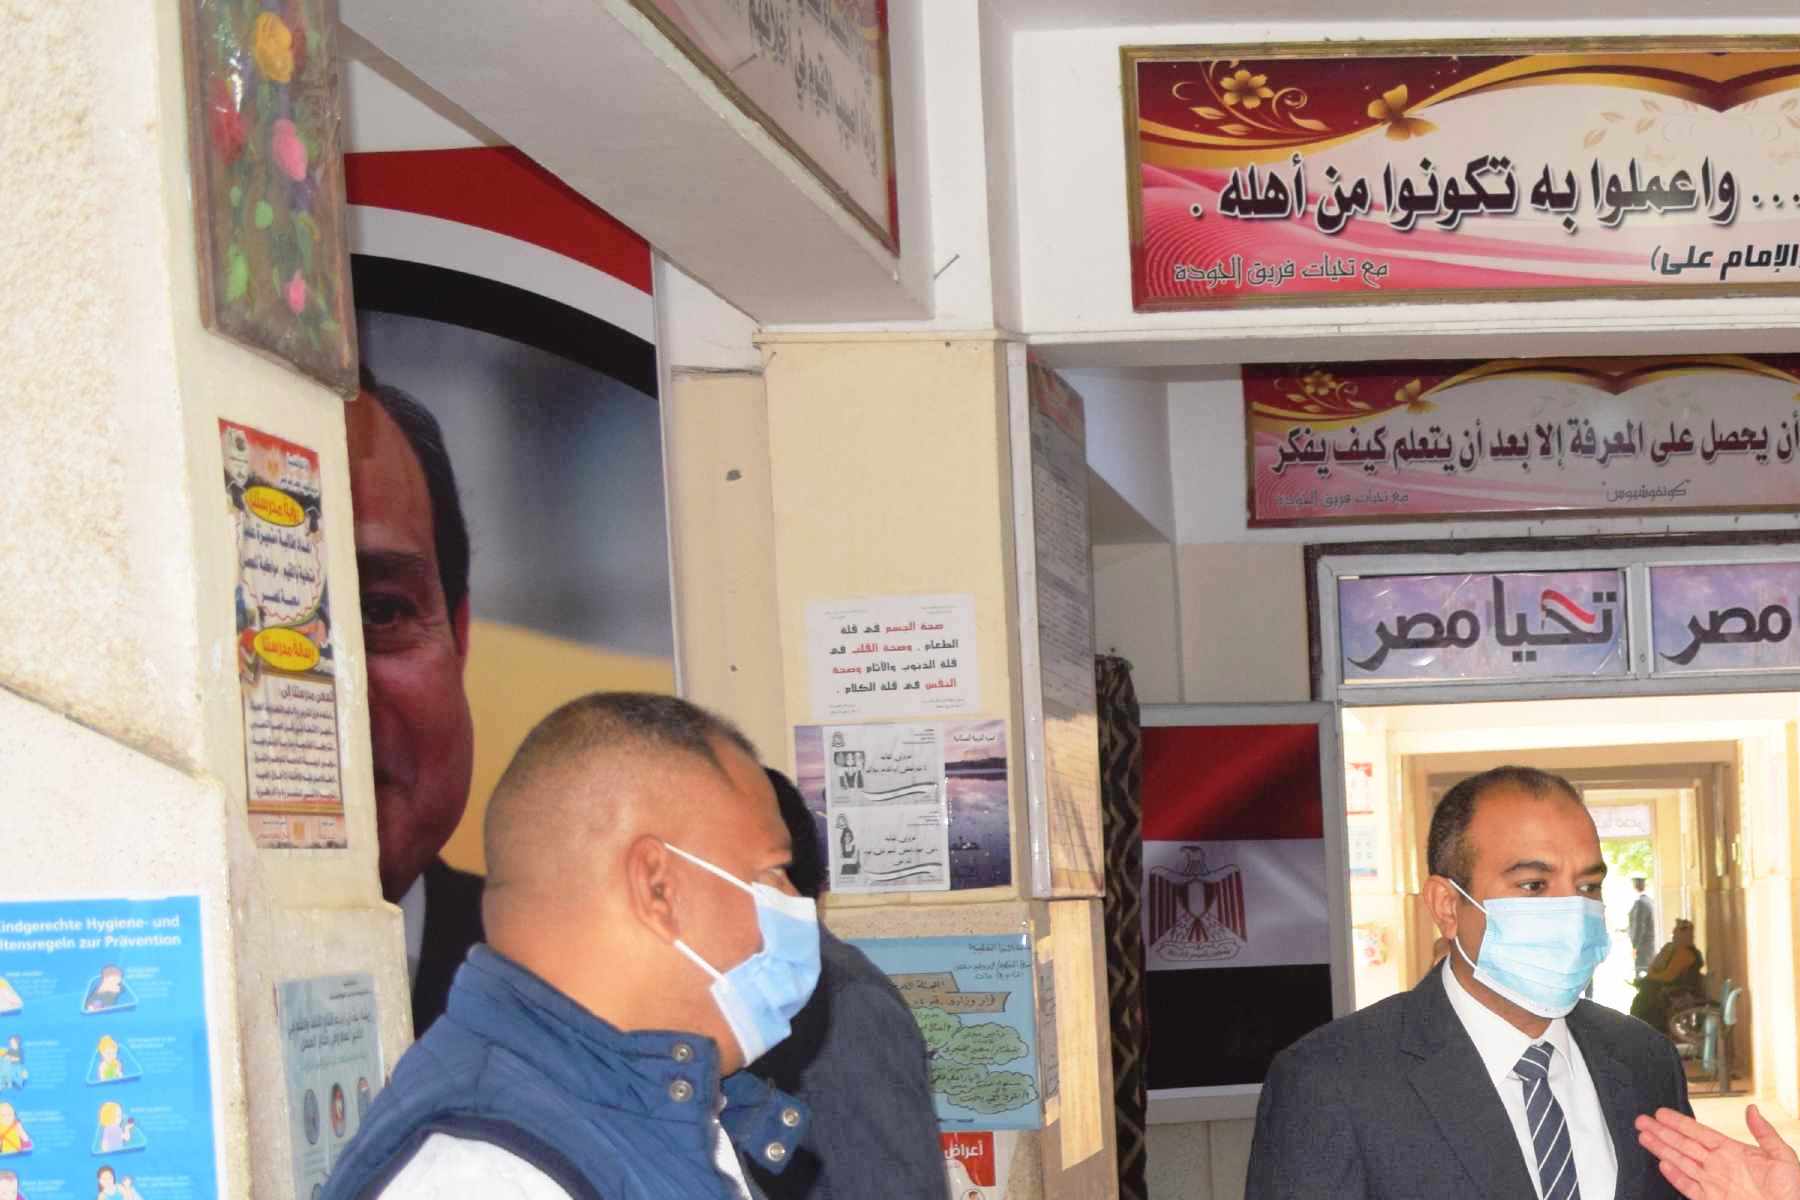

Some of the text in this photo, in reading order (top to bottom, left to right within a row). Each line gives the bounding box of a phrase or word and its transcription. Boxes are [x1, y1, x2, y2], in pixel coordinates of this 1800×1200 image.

[1217, 153, 1308, 218] أهله
[1312, 163, 1372, 233] من
[1382, 154, 1521, 228] تكونوا
[1528, 162, 1578, 236] به
[1590, 154, 1740, 226] واعملوا
[1174, 253, 1243, 288] الجودة
[1248, 259, 1295, 287] فريق
[1361, 262, 1389, 288] مع
[1272, 425, 1330, 477] يفكر
[1333, 425, 1387, 474] كيف
[1392, 423, 1454, 473] يتعلم
[1459, 418, 1483, 470] أن
[1489, 424, 1529, 472] بعد
[1534, 421, 1563, 470] إلا
[1569, 417, 1643, 465] المعرفة
[1650, 419, 1695, 464] على
[1701, 418, 1769, 463] يحصل
[1775, 410, 1800, 463] أن
[1346, 574, 1618, 672] تحيا مصر
[1658, 603, 1791, 667] مصر
[0, 933, 182, 953] ltensregeln zur Prävention
[86, 916, 148, 933] Hygiene-
[152, 915, 181, 929] und
